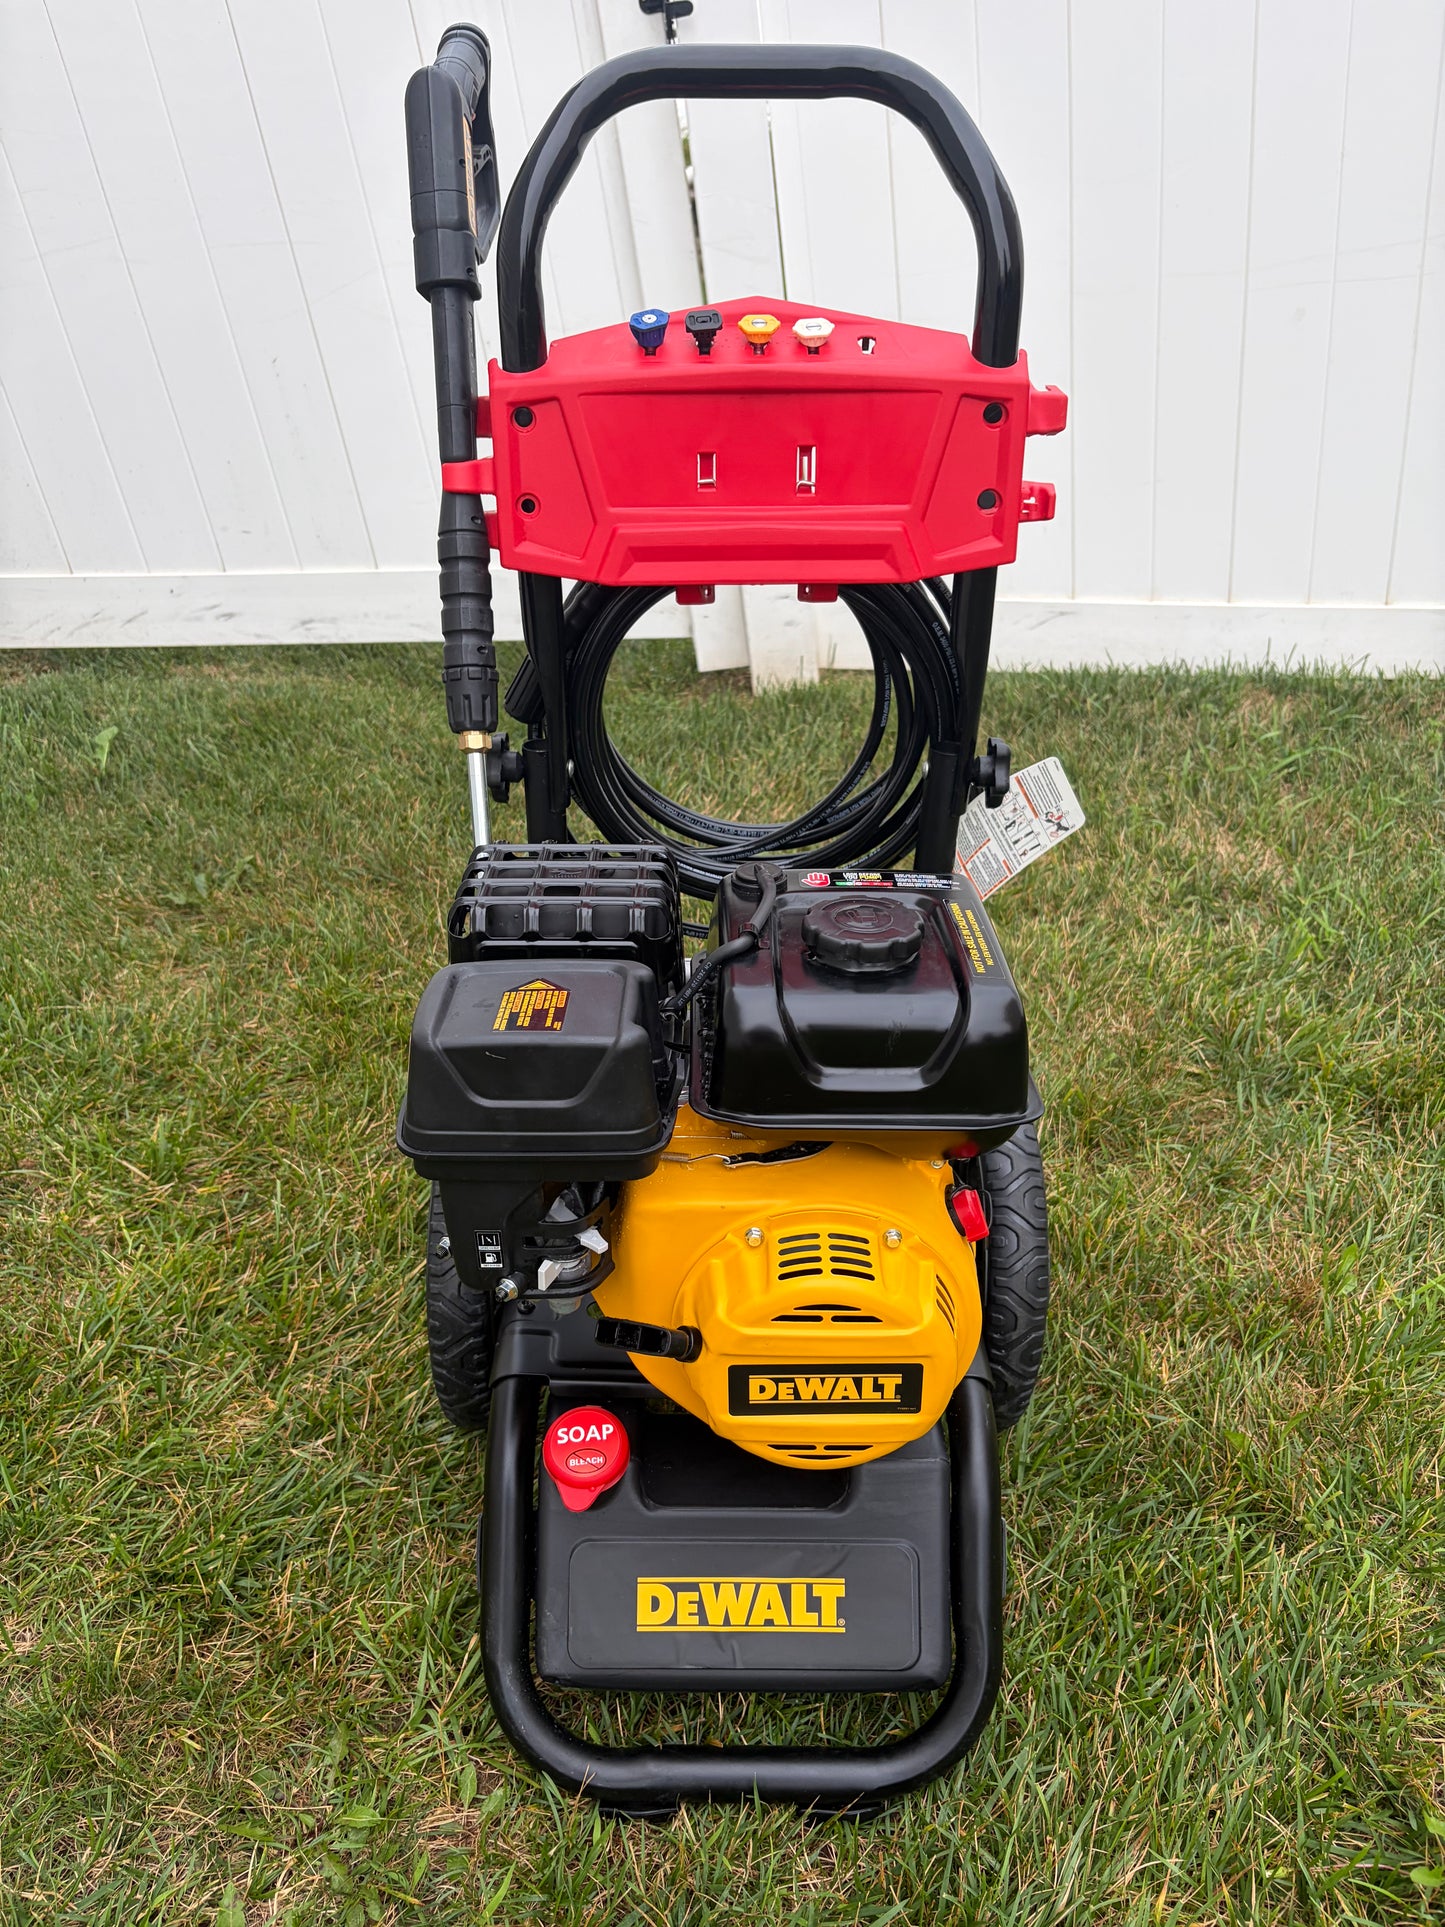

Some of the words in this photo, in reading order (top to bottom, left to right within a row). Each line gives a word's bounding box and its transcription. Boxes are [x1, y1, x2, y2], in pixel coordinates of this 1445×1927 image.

[949, 902, 969, 930] CALIFORNIA
[964, 909, 980, 932] CALIFORNIA
[964, 935, 977, 949] SALE
[978, 937, 991, 953] VENTA
[970, 948, 982, 961] FOR
[985, 958, 995, 967] NO
[974, 960, 987, 974] NOT
[748, 1376, 903, 1402] DEWALT
[556, 1423, 615, 1445] SOAP
[569, 1456, 603, 1467] BLEACH
[636, 1582, 846, 1627] DEWALT
